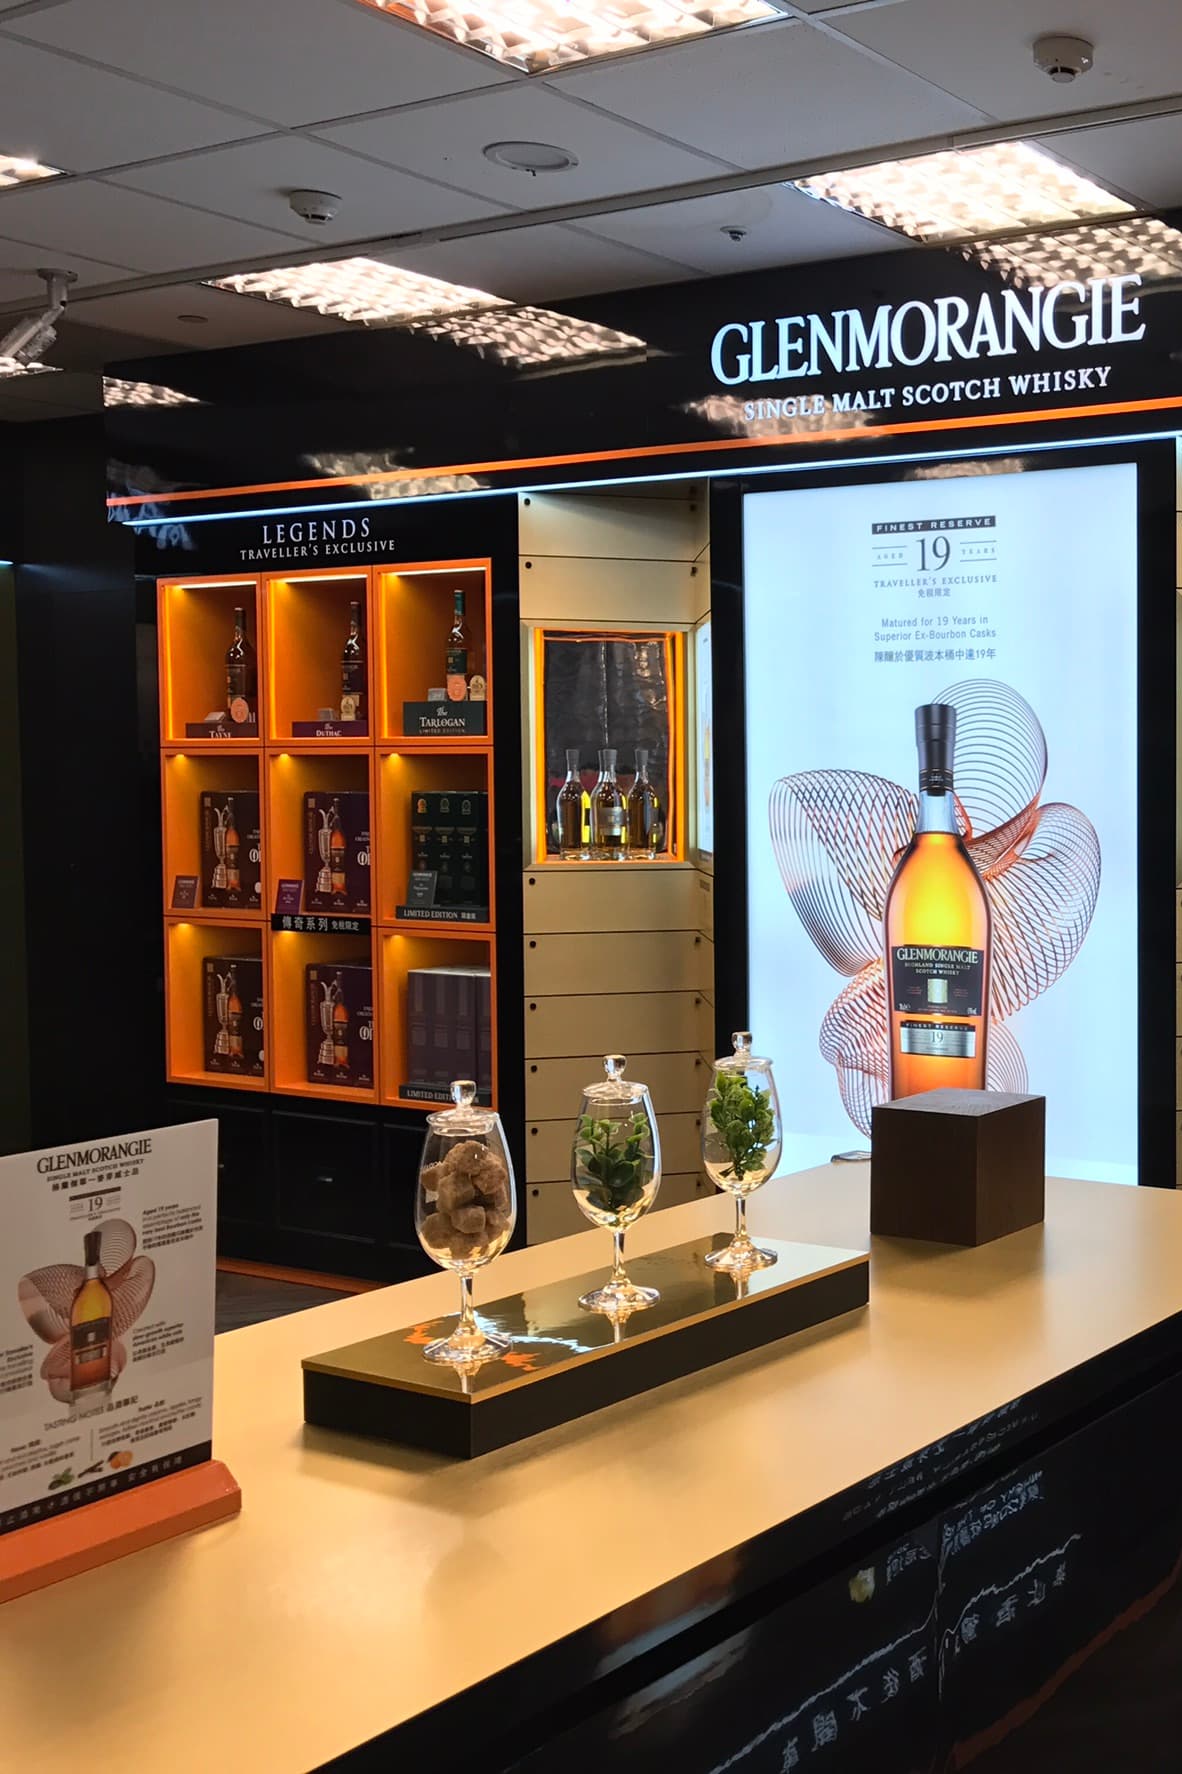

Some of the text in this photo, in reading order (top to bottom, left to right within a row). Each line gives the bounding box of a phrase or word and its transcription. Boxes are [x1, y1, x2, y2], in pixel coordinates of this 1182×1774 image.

[711, 274, 1146, 385] GLENMORANGIE
[744, 366, 1112, 421] SINGLE MALT SCOTCH WHISKY
[262, 518, 371, 544] LEGENDS
[876, 518, 991, 533] FINEST RESERVE
[240, 540, 396, 561] TRAVELLER'S EXCLUSIVE
[916, 536, 951, 572] 19
[874, 574, 998, 588] TRAVELLER'S EXCLUSIVE
[881, 615, 989, 628] Matured for 19 Years in
[874, 628, 996, 643] Superior Ex-Bourbon Casks
[419, 717, 465, 728] TARLOGAN
[404, 909, 430, 918] LIMITED
[431, 910, 458, 919] EDITION
[282, 915, 328, 931] 傳奇系列
[896, 948, 979, 964] GLENMORANGIE
[931, 1031, 944, 1043] 19
[36, 1138, 153, 1174] GLENMORANGIE
[46, 1172, 71, 1183] SINGLE
[73, 1168, 91, 1178] MALT
[92, 1163, 118, 1174] SCOTCH
[87, 1196, 104, 1212] 19
[43, 1415, 77, 1431] TASTING
